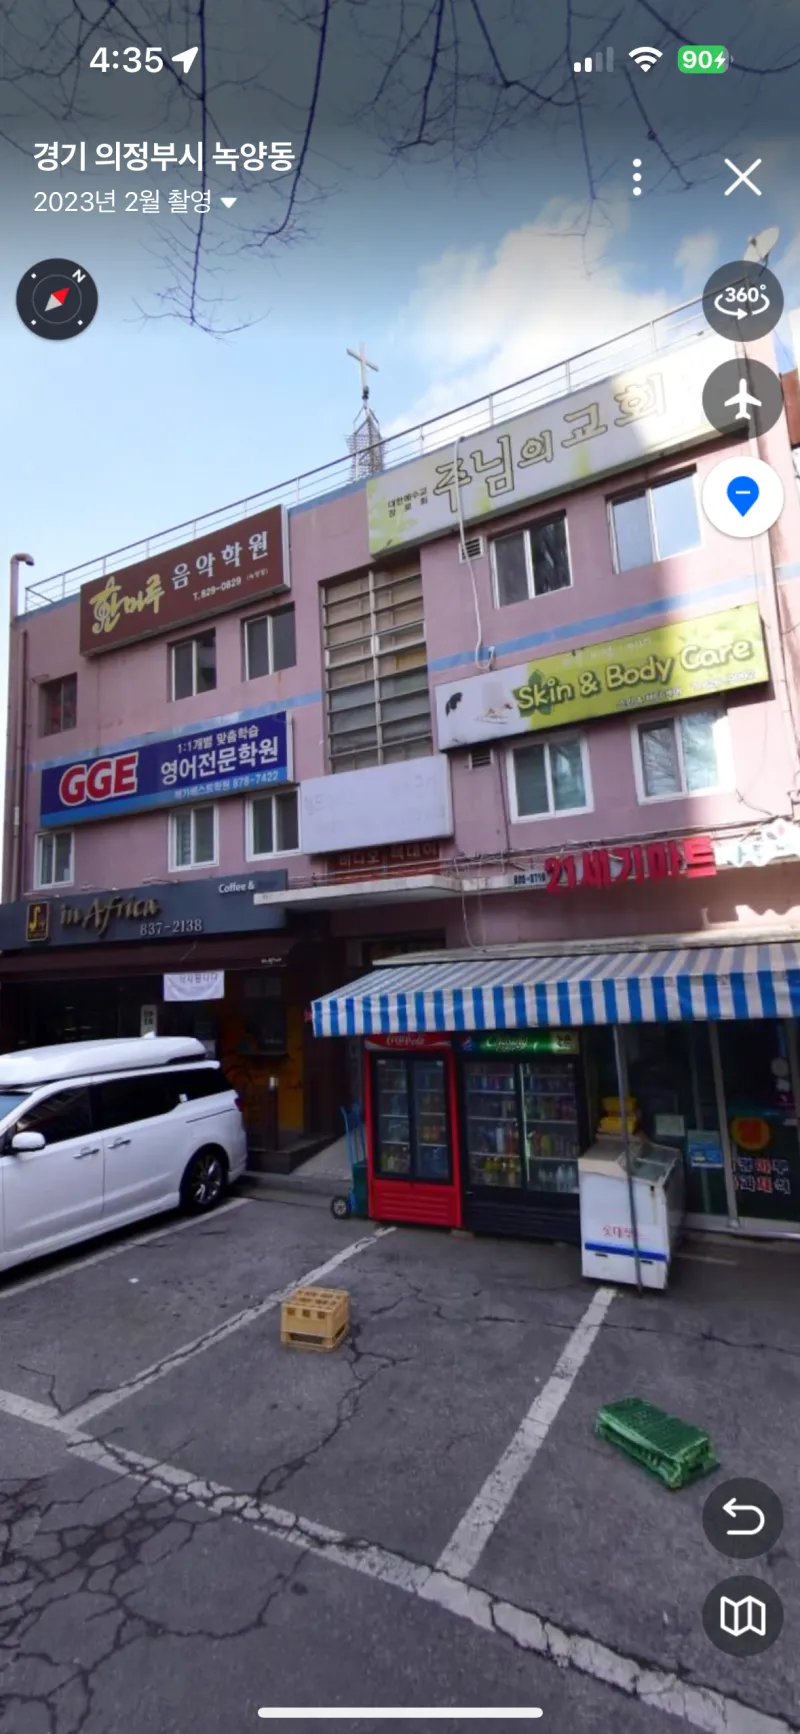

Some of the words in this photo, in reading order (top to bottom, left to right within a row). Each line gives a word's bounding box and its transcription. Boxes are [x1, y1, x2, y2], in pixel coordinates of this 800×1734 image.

[433, 430, 555, 513] 주님의
[561, 372, 667, 448] 교회
[171, 531, 268, 590] 음악학원
[516, 677, 574, 711] Skin
[580, 671, 600, 697] &
[606, 655, 674, 689] Body
[680, 640, 753, 671] Care
[161, 736, 279, 786] 영어전문학원
[177, 735, 213, 754] 1:1개별
[216, 724, 260, 746] 맞춤학습
[59, 751, 139, 807] GGE
[232, 771, 279, 788] 878-7422
[218, 880, 247, 894] Coffee
[247, 879, 256, 891] &
[544, 836, 717, 893] 21세기마트
[81, 895, 160, 936] Africa
[139, 919, 203, 936] 837-2138
